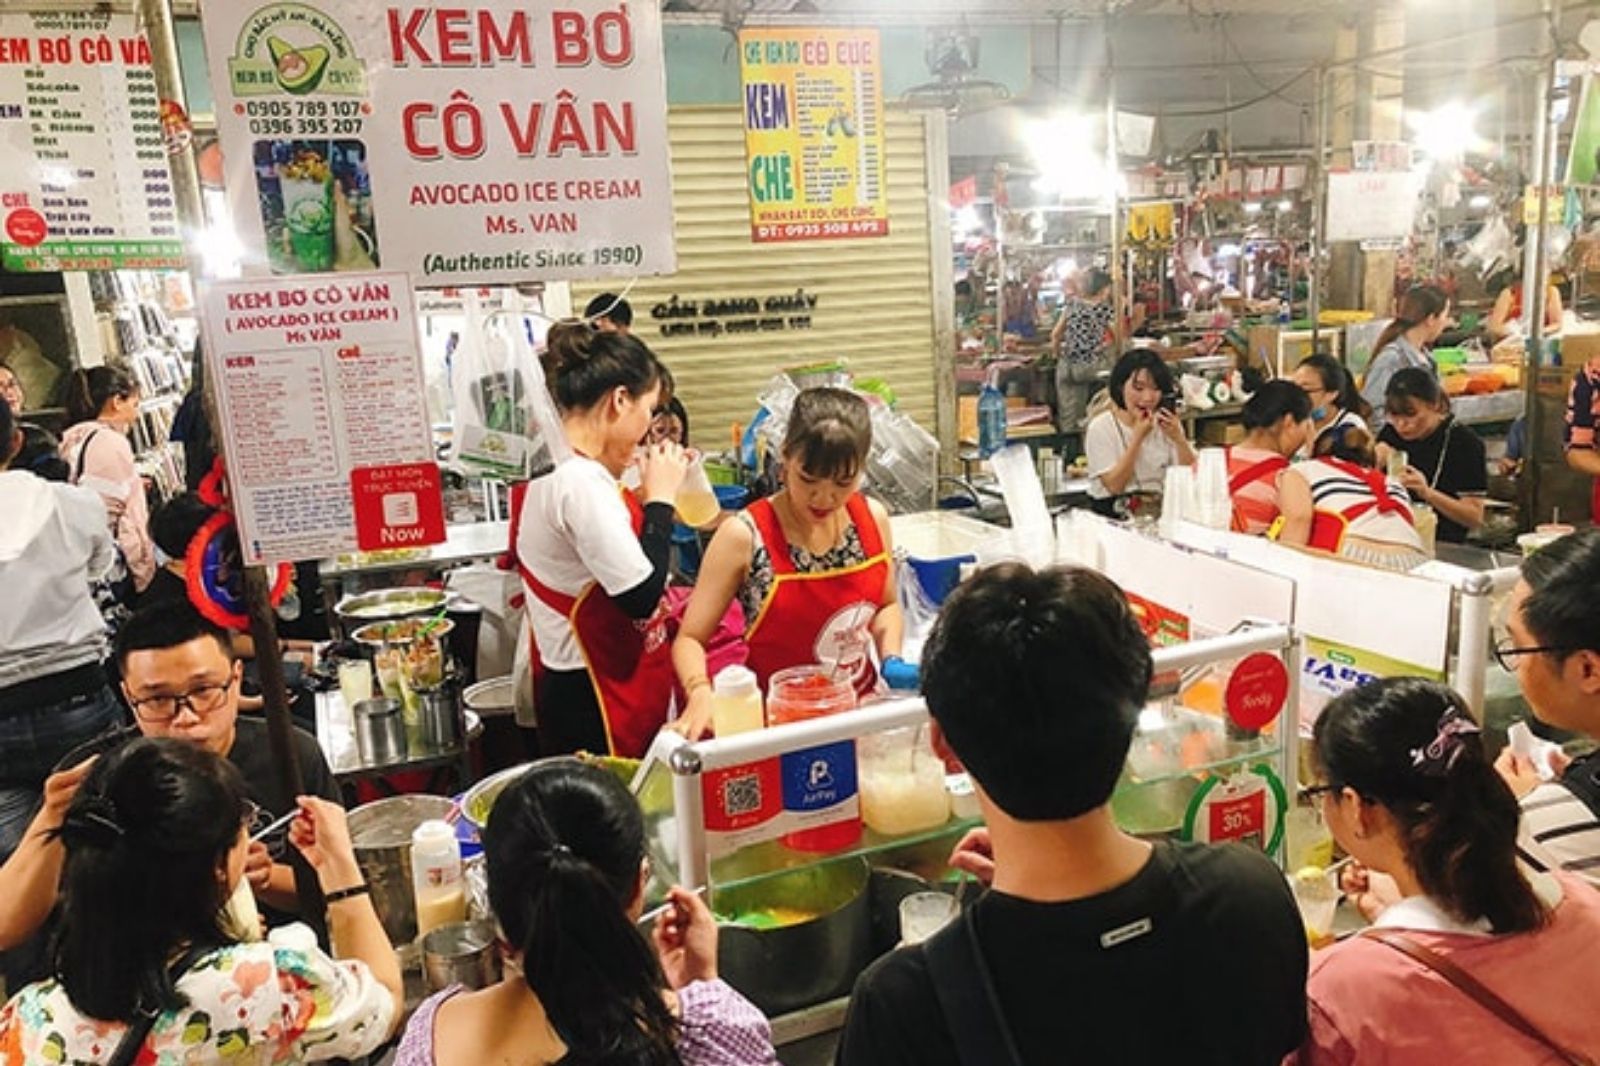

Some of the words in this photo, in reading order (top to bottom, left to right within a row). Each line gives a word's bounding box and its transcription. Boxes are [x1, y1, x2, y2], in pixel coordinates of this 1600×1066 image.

[387, 8, 536, 68] KEM
[551, 4, 634, 68] BƠ
[0, 38, 30, 63] EM
[119, 35, 153, 64] VÂ
[247, 101, 292, 116] 0905
[295, 101, 327, 116] 789
[331, 101, 360, 116] 107
[746, 83, 789, 129] KEM
[249, 118, 293, 134] 0396
[296, 118, 328, 134] 395
[332, 118, 363, 134] 207
[402, 89, 488, 161] CÔ
[499, 89, 639, 158] VÂN
[410, 183, 518, 205] AVOCADO
[525, 181, 558, 202] ICE
[562, 180, 641, 201] CREAM
[486, 215, 524, 235] Ms.
[530, 212, 578, 234] VAN
[423, 251, 529, 275] (Authentic
[593, 244, 643, 267] 1990)
[228, 292, 273, 311] KEM
[277, 289, 307, 308] BƠ
[313, 285, 342, 303] CÔ
[346, 283, 390, 302] VÂN
[236, 312, 310, 331] AVOCADO
[315, 310, 337, 325] ICE
[339, 308, 389, 324] CREAM
[286, 331, 306, 345] Ms
[381, 528, 425, 543] Now
